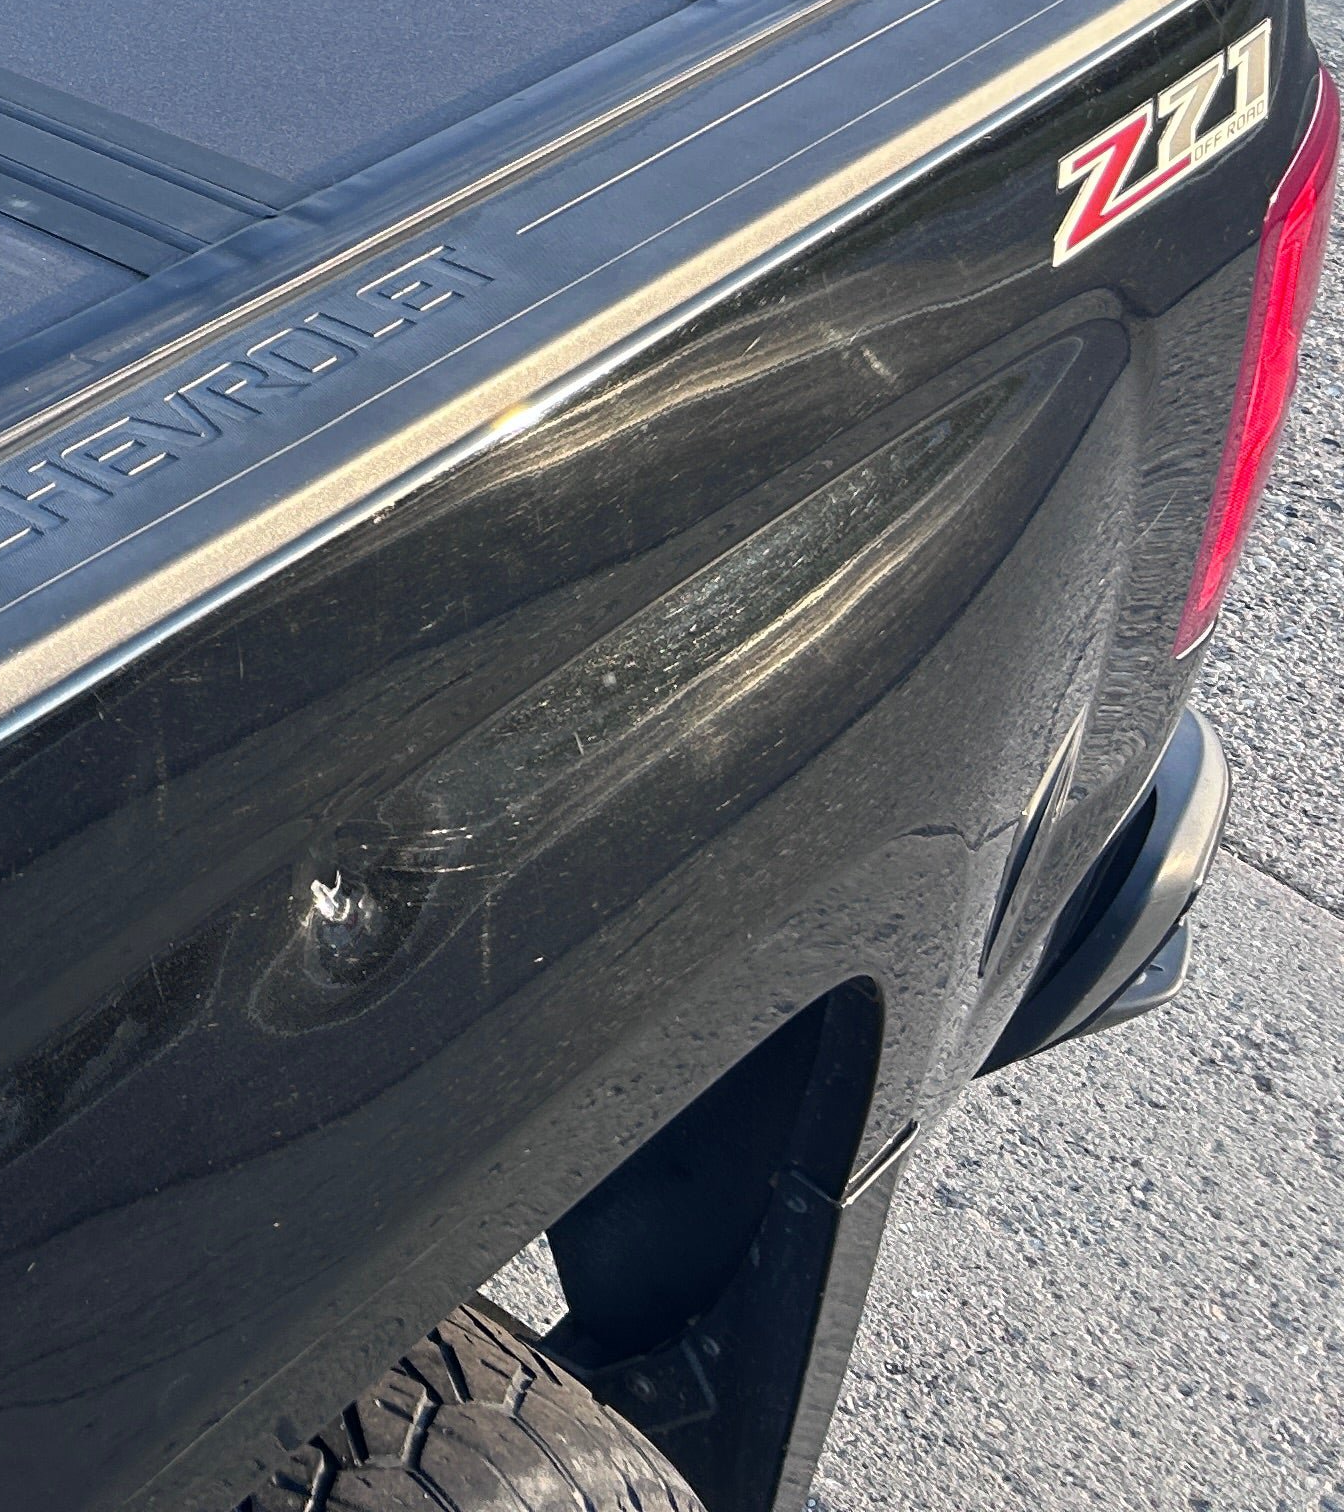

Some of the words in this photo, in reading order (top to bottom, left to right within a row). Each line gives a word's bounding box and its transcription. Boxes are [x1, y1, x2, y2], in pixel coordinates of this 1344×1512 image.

[1053, 19, 1272, 267] Z71
[1194, 131, 1222, 162] OFF
[1226, 99, 1265, 137] ROAD
